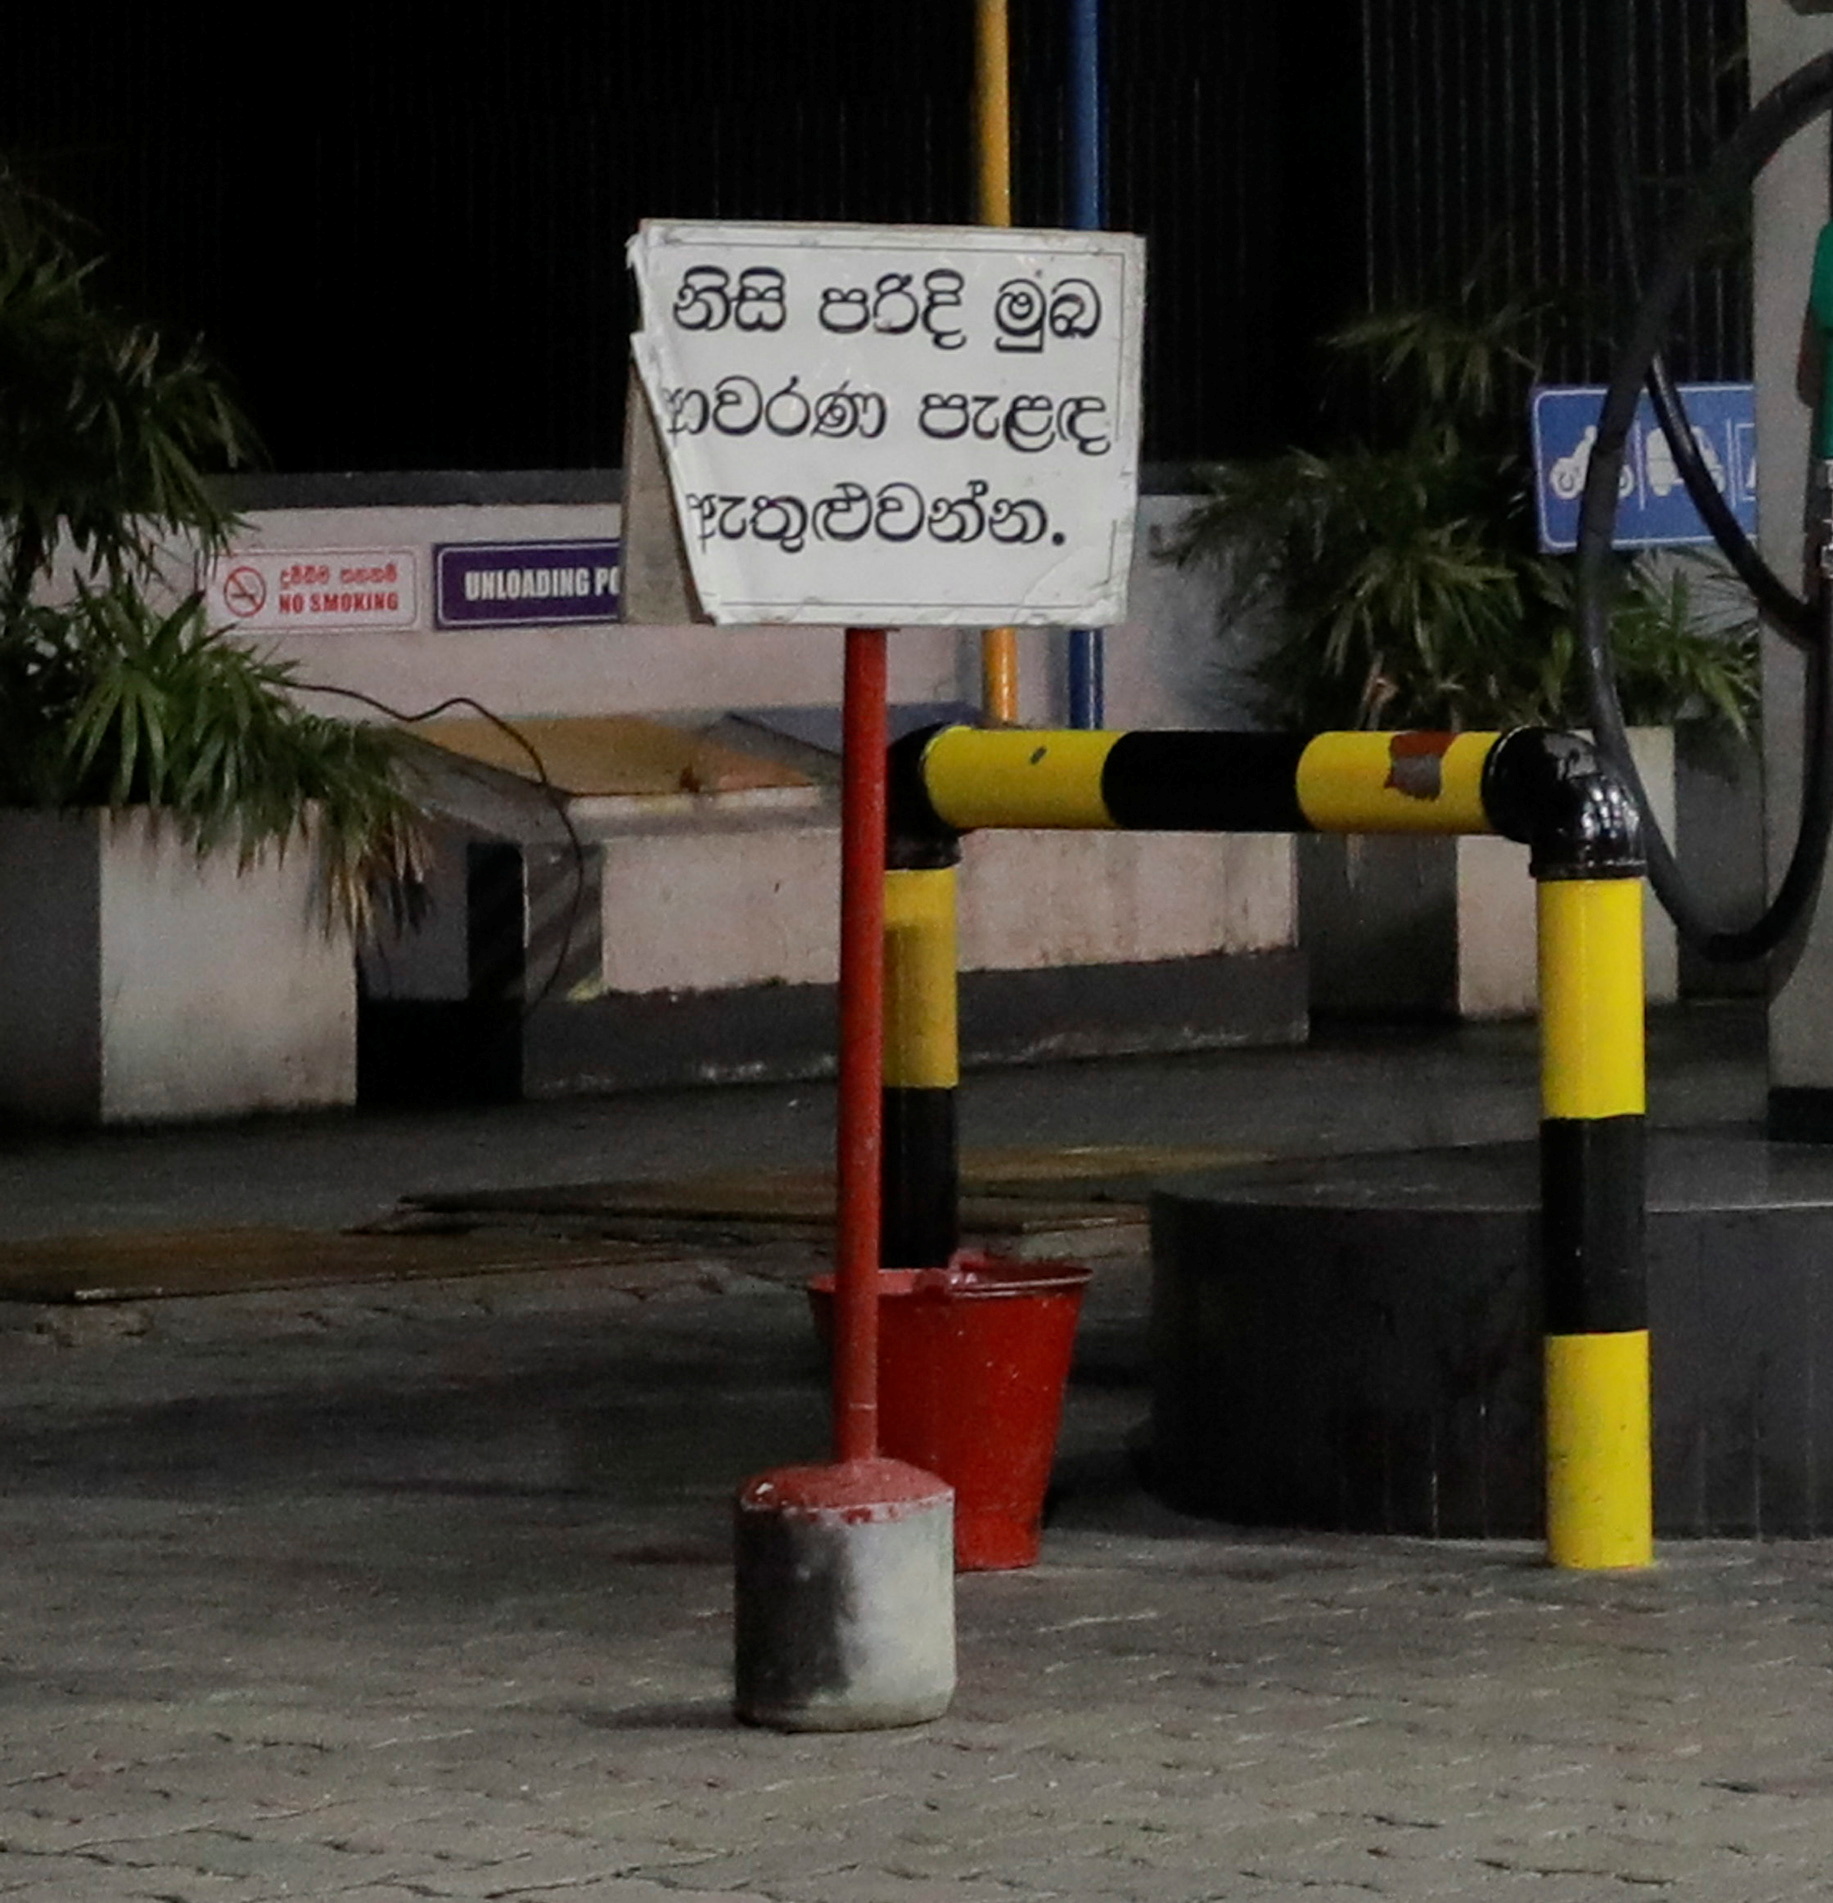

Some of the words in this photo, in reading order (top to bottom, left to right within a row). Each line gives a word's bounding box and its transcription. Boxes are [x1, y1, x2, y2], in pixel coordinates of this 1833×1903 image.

[673, 264, 787, 332] නිසි
[818, 268, 967, 351] පරිදි
[464, 566, 589, 601] UNLOADING
[279, 593, 303, 614] NO
[310, 592, 398, 612] SMOKING
